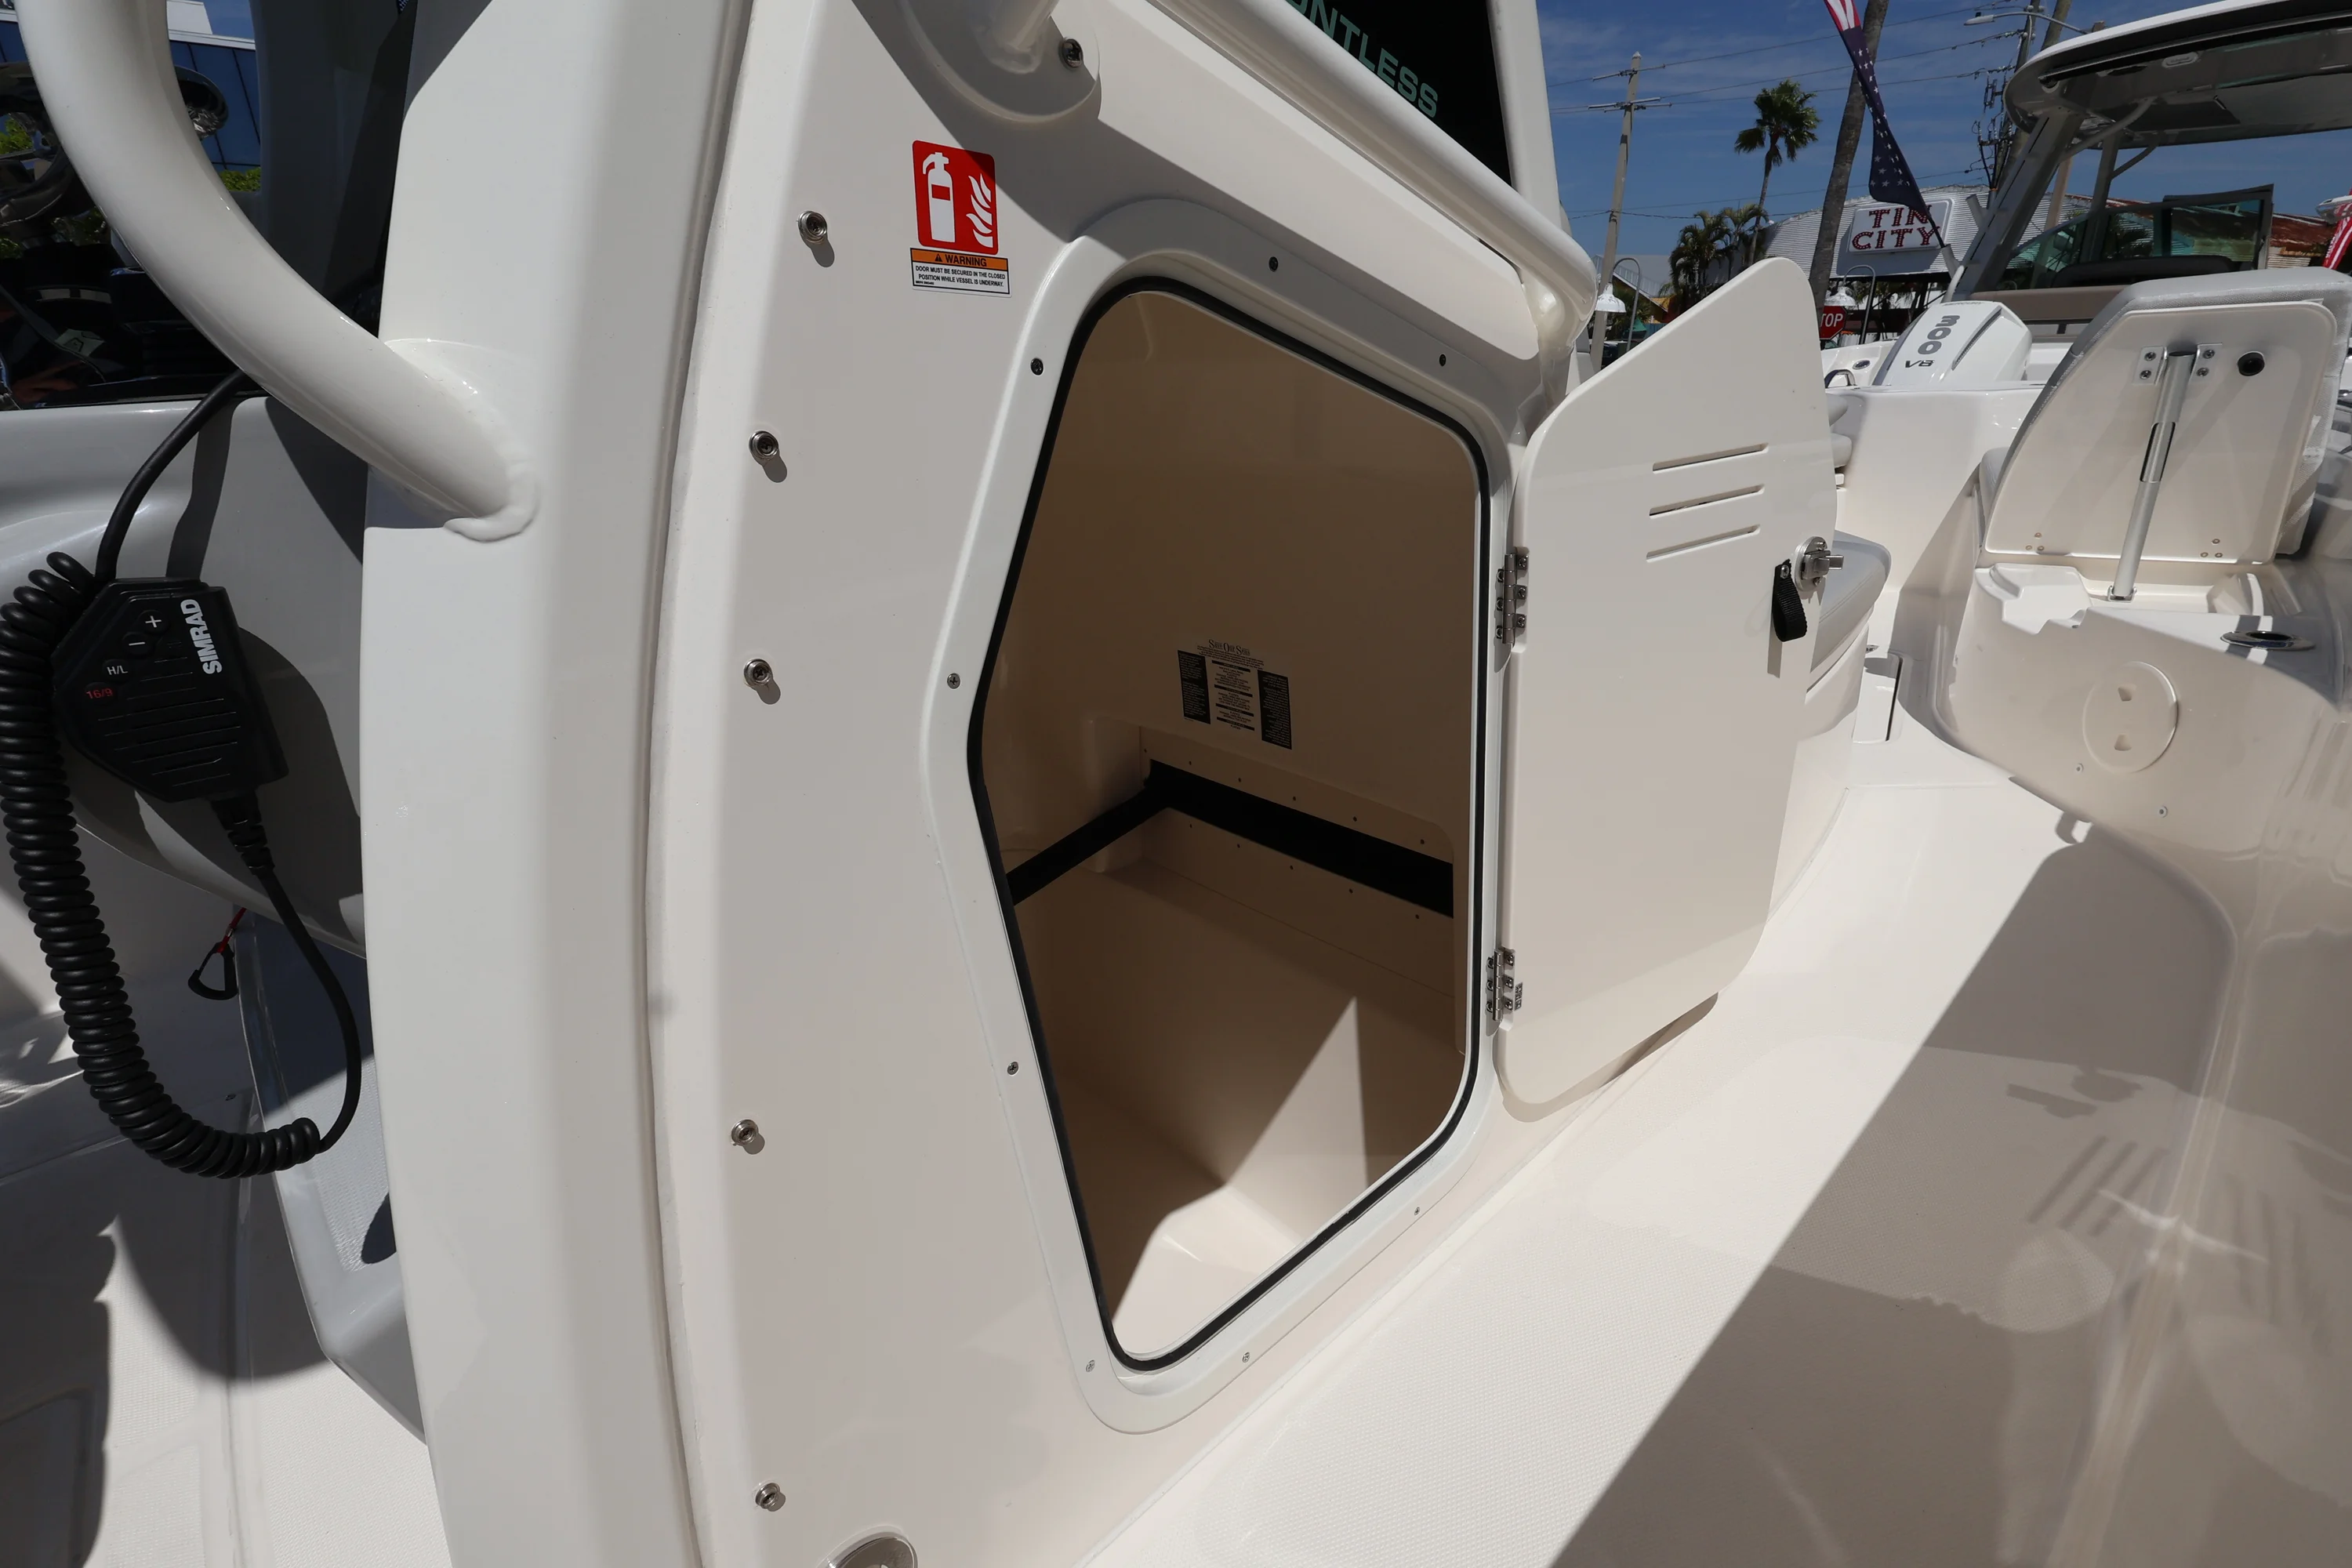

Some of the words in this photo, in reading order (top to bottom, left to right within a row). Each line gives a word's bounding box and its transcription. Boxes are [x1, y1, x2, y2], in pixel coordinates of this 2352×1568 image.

[1287, 0, 1438, 118] NTLESS
[1869, 205, 1933, 228] TIN
[1852, 226, 1940, 250] CITY
[945, 254, 987, 267] WARNING
[979, 278, 1004, 287] UNDERWAY.
[1820, 313, 1843, 328] TOP
[1917, 314, 1961, 354] 300
[180, 599, 223, 674] SIMRAD
[107, 665, 128, 676] H/L
[85, 688, 113, 699] 16/9
